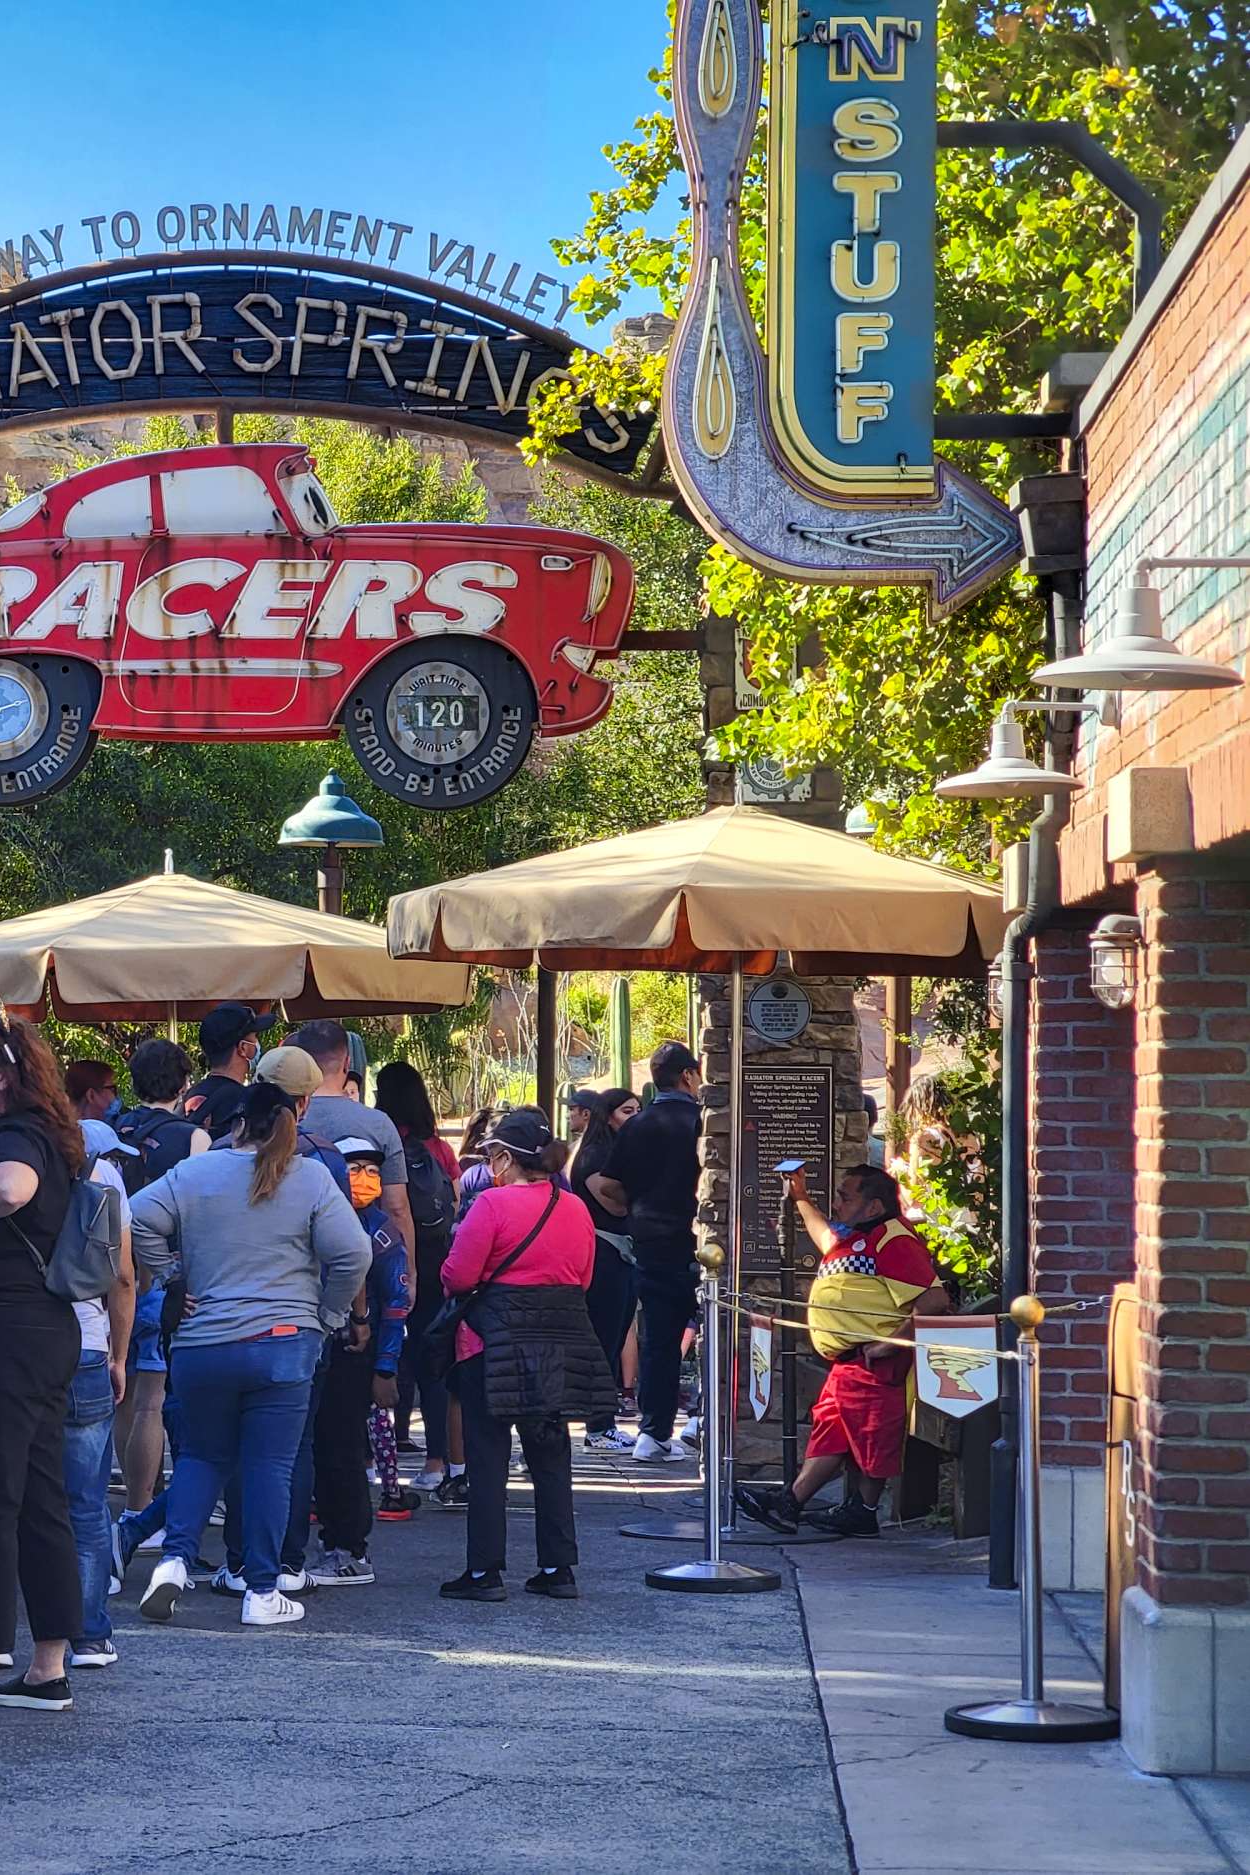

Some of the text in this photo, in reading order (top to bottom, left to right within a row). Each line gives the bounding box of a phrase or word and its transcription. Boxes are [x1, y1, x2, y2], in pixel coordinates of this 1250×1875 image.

[82, 211, 141, 254] TO
[157, 203, 412, 260] ORNAMENT
[429, 232, 574, 323] VALLEY
[830, 98, 903, 443] STUFF
[409, 674, 466, 692] WAIT TIME
[415, 700, 464, 727] 120
[0, 706, 82, 793] ENTRANCE
[354, 706, 522, 796] STAND-BY ENTRANCE
[412, 737, 463, 753] MINUTES
